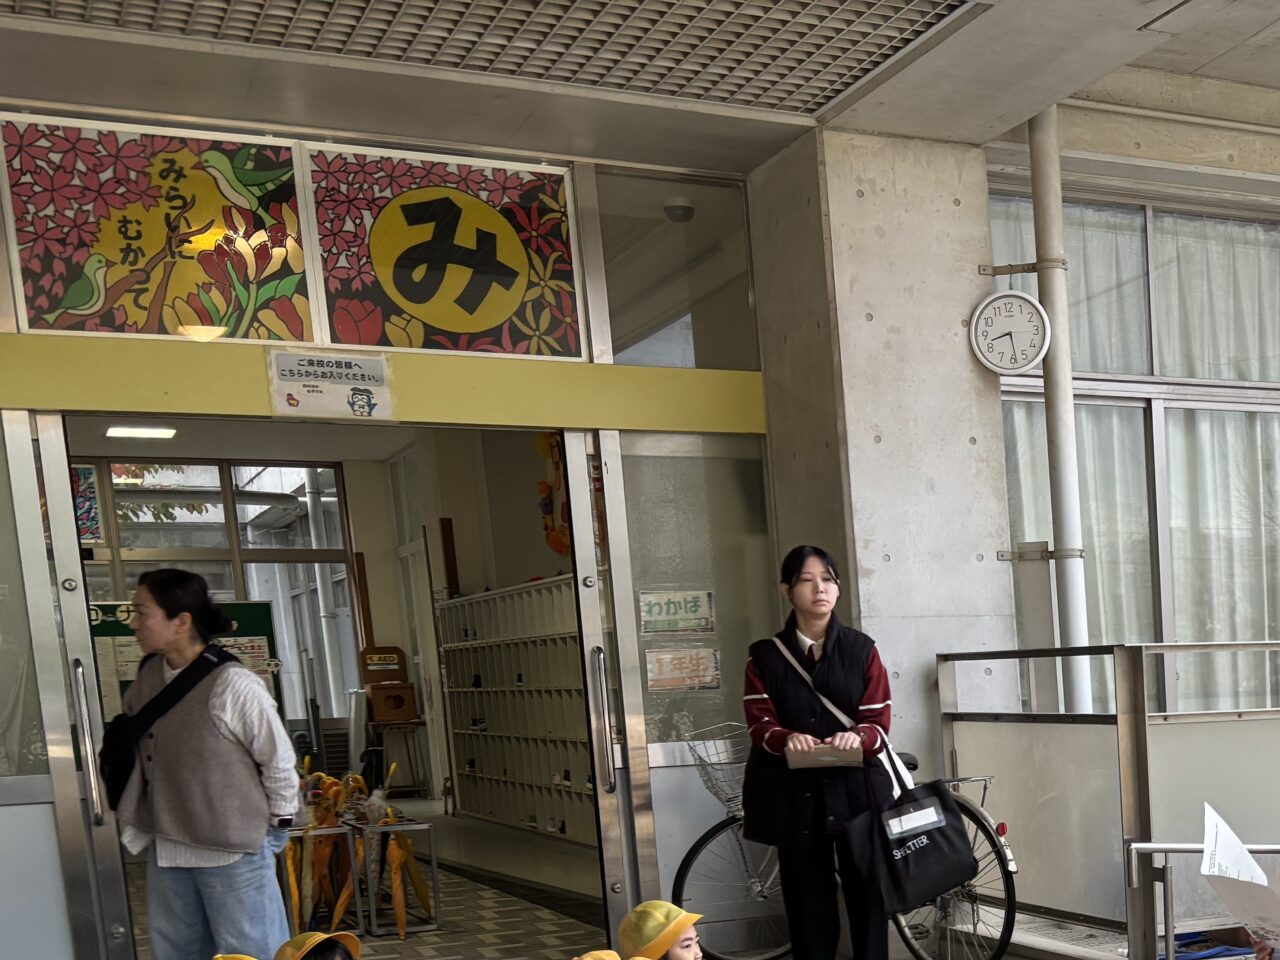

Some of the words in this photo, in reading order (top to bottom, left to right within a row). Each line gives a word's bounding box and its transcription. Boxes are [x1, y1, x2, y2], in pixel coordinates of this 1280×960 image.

[158, 157, 195, 260] みらいに
[392, 196, 520, 316] み
[993, 306, 1002, 317] 11
[1003, 301, 1014, 313] 12
[1018, 304, 1023, 315] 1
[984, 316, 994, 328] 10
[1027, 311, 1034, 322] 2
[981, 330, 989, 341] 9
[1032, 324, 1040, 336] 3
[987, 342, 994, 353] 8
[1029, 338, 1036, 348] 4
[998, 351, 1005, 362] 7
[1009, 353, 1017, 364] 6
[1021, 350, 1028, 361] 5
[297, 358, 363, 370] ご来校の皆様へ
[644, 596, 702, 617] わかば
